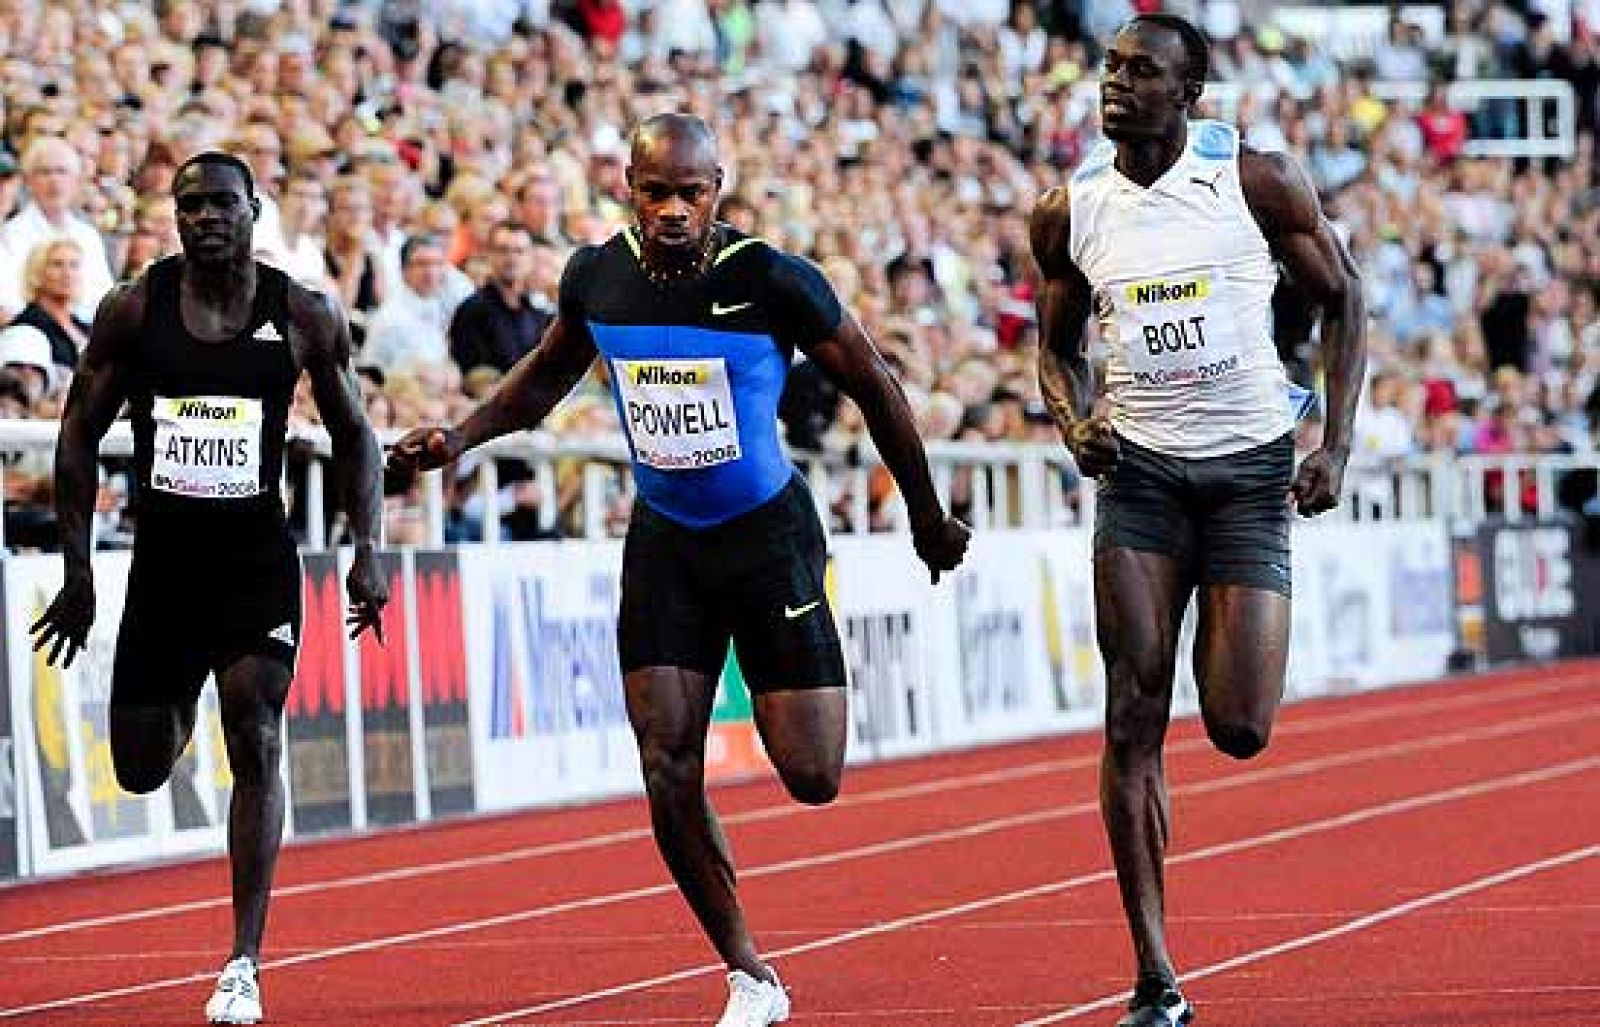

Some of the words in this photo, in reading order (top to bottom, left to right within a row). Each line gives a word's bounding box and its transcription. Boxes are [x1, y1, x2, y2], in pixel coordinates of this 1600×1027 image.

[1137, 281, 1197, 304] Nikon
[1143, 316, 1205, 355] BOLT
[636, 366, 696, 384] Nikon
[177, 401, 236, 419] Nikon
[628, 399, 729, 436] POWELL
[165, 433, 248, 466] ATKINS
